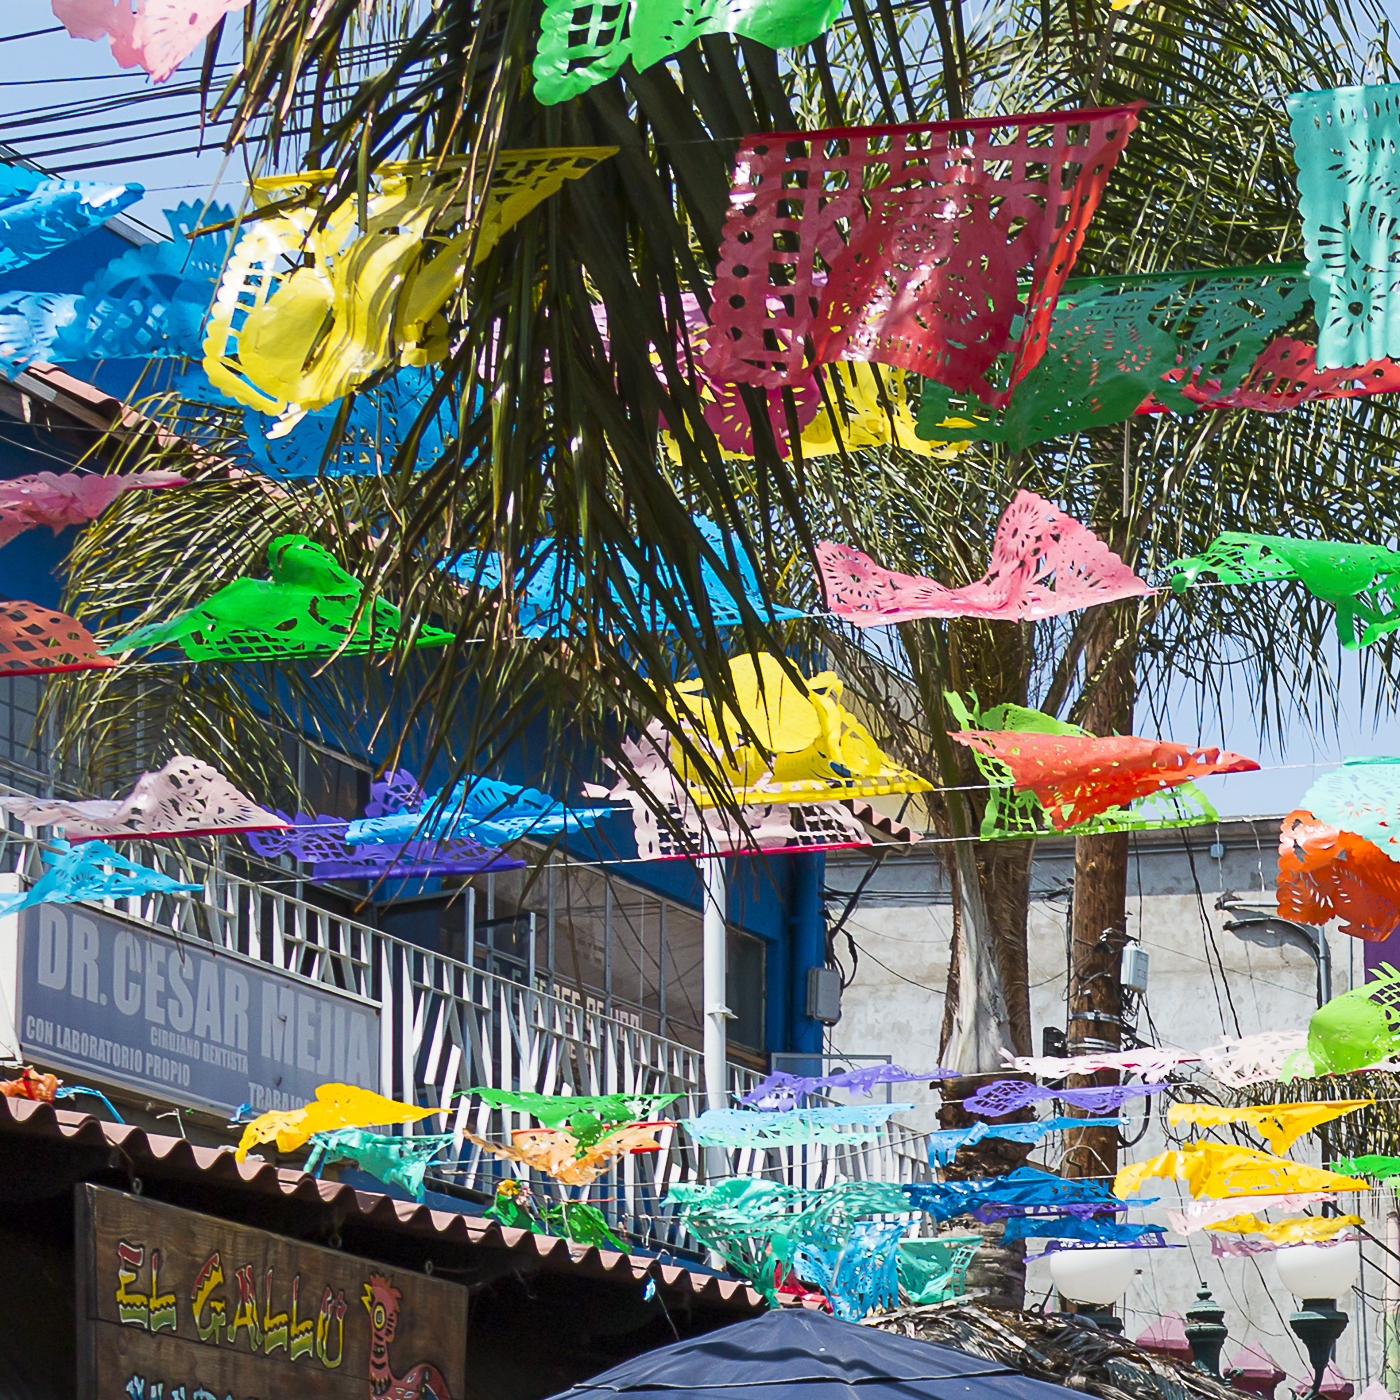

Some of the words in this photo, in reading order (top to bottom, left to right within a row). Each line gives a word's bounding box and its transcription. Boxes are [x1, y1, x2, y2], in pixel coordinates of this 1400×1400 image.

[37, 903, 107, 1006] DR.
[112, 931, 250, 1051] CESAR
[261, 981, 373, 1085] MEJIA
[26, 1015, 53, 1046] CON
[56, 1024, 143, 1073] LABORATORIO
[146, 1053, 191, 1087] PROPIO
[150, 1027, 200, 1060] CIRUJANO
[203, 1042, 249, 1075] DENTISTA
[116, 1239, 178, 1333] EL
[191, 1253, 348, 1370] GALLO
